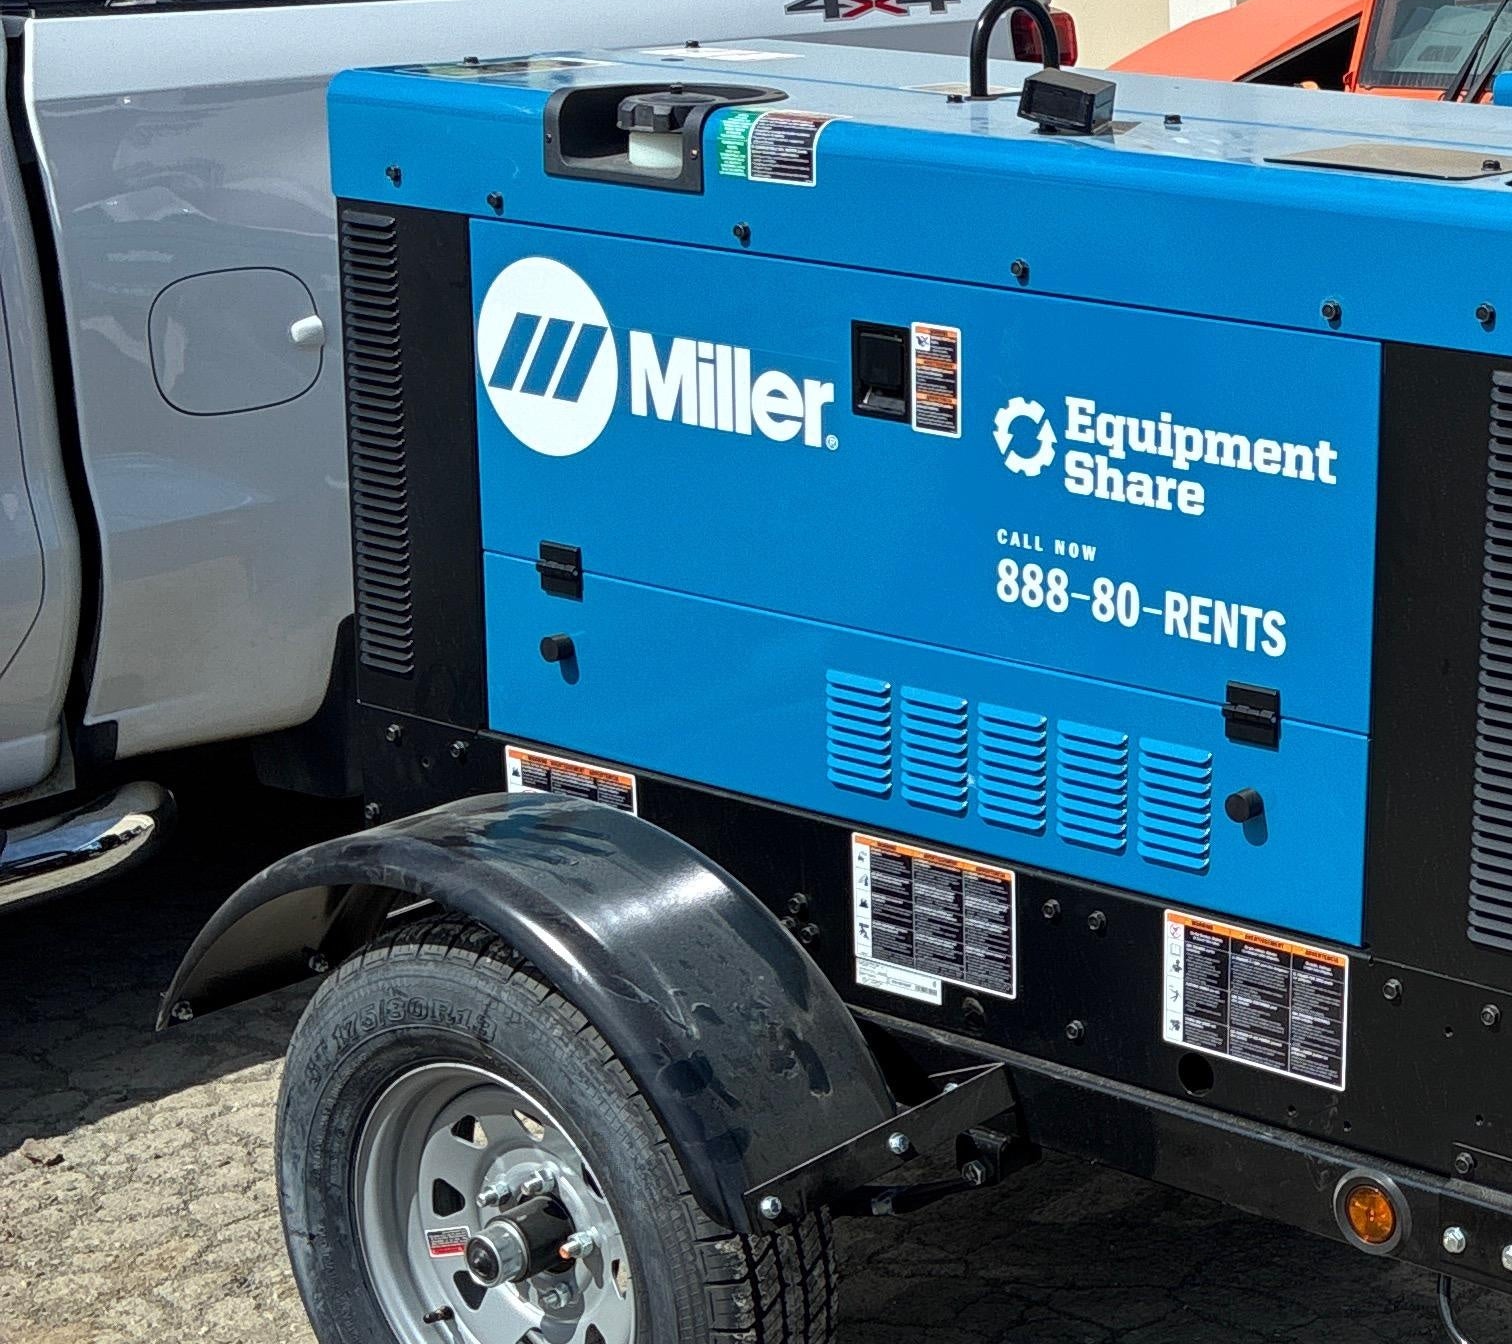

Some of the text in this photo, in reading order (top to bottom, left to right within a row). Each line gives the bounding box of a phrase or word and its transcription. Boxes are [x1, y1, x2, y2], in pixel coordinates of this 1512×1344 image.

[629, 329, 836, 449] Miller
[1064, 395, 1338, 485] Equipment
[1064, 450, 1205, 516] Share
[996, 528, 1097, 562] CALL NOW
[996, 558, 1287, 658] 888-80-RENTS
